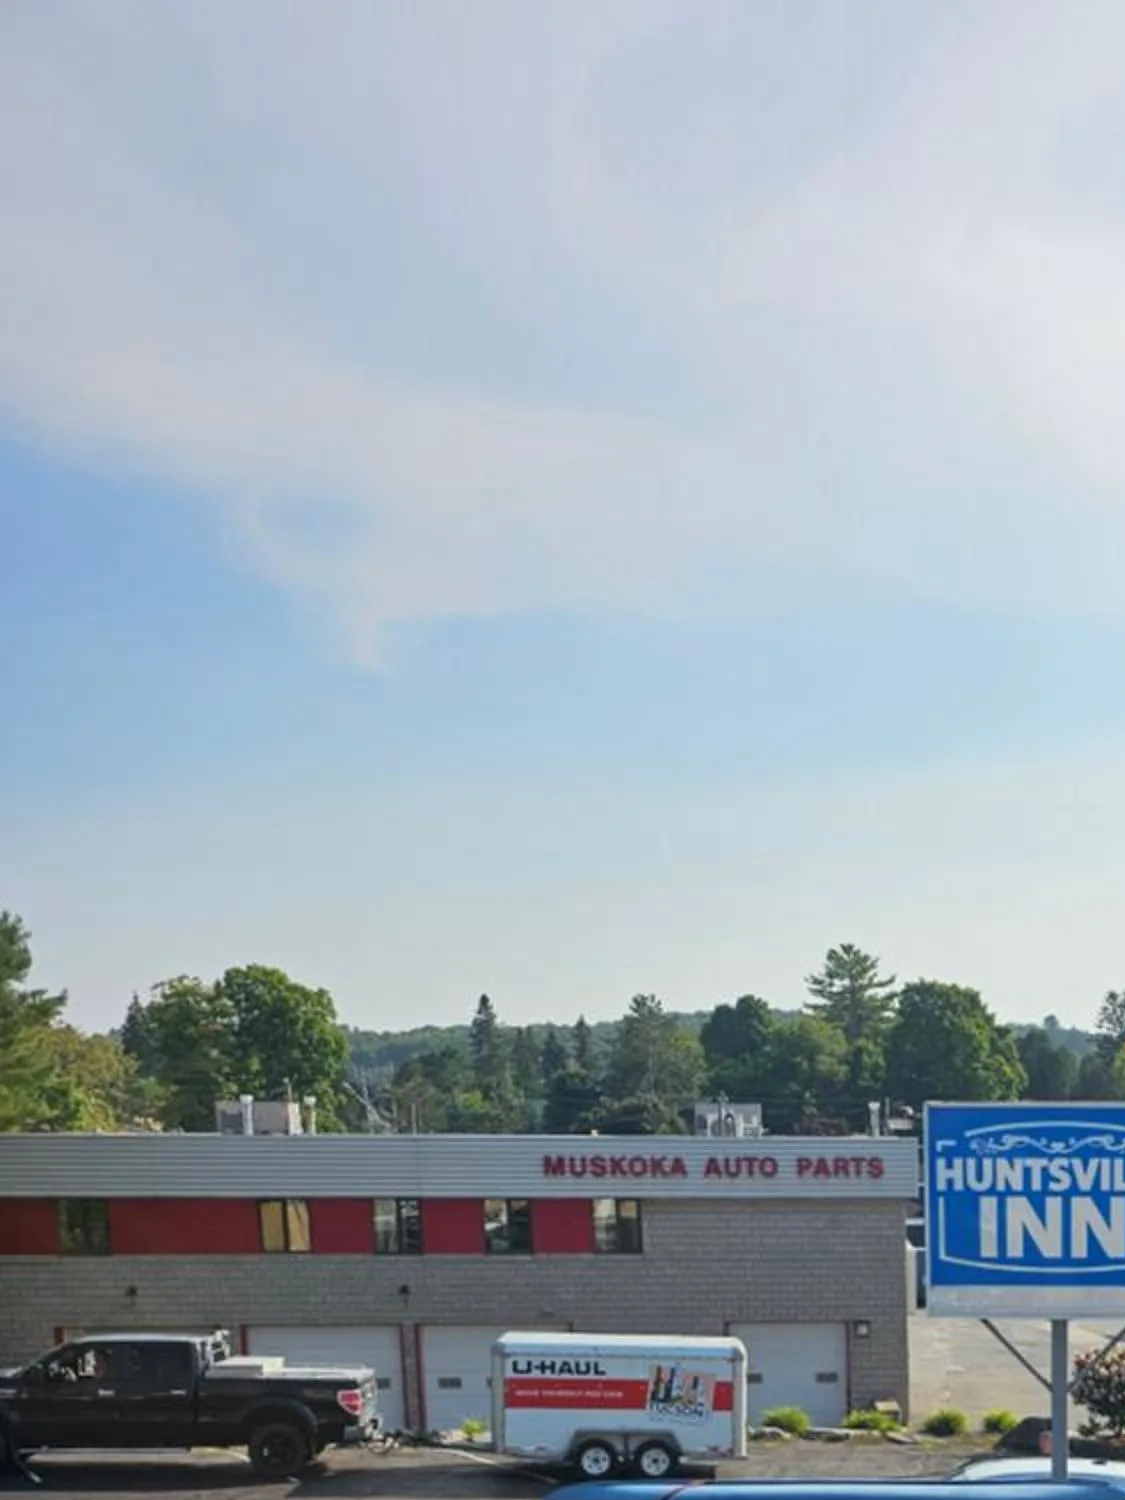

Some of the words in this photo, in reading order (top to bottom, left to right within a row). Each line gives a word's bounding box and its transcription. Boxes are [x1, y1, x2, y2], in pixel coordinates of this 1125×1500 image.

[542, 1155, 688, 1179] MUSKOKA
[703, 1156, 779, 1179] AUTO
[796, 1156, 885, 1179] PARTS
[512, 1360, 607, 1376] U-HAUL
